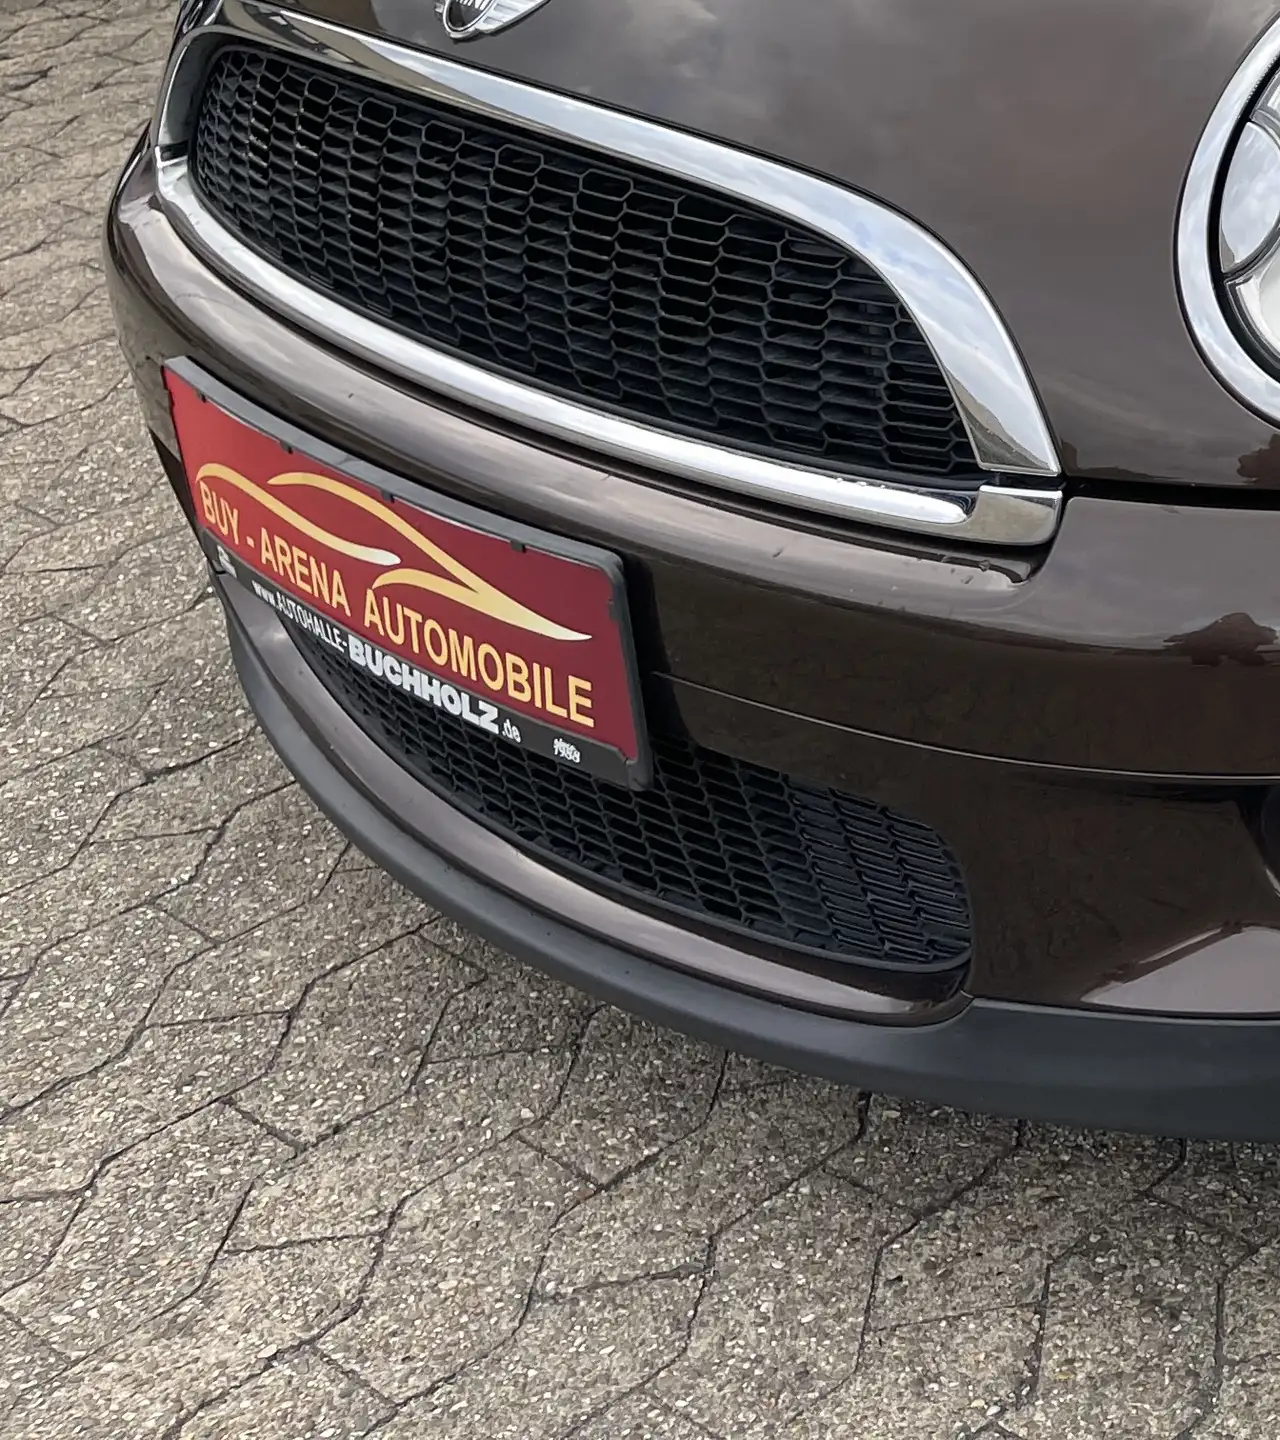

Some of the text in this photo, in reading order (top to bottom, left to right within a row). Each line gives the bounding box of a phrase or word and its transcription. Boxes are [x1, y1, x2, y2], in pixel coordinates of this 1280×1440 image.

[199, 480, 239, 546] BUY
[260, 526, 351, 618] ARENA
[364, 588, 595, 729] AUTOMOBILE
